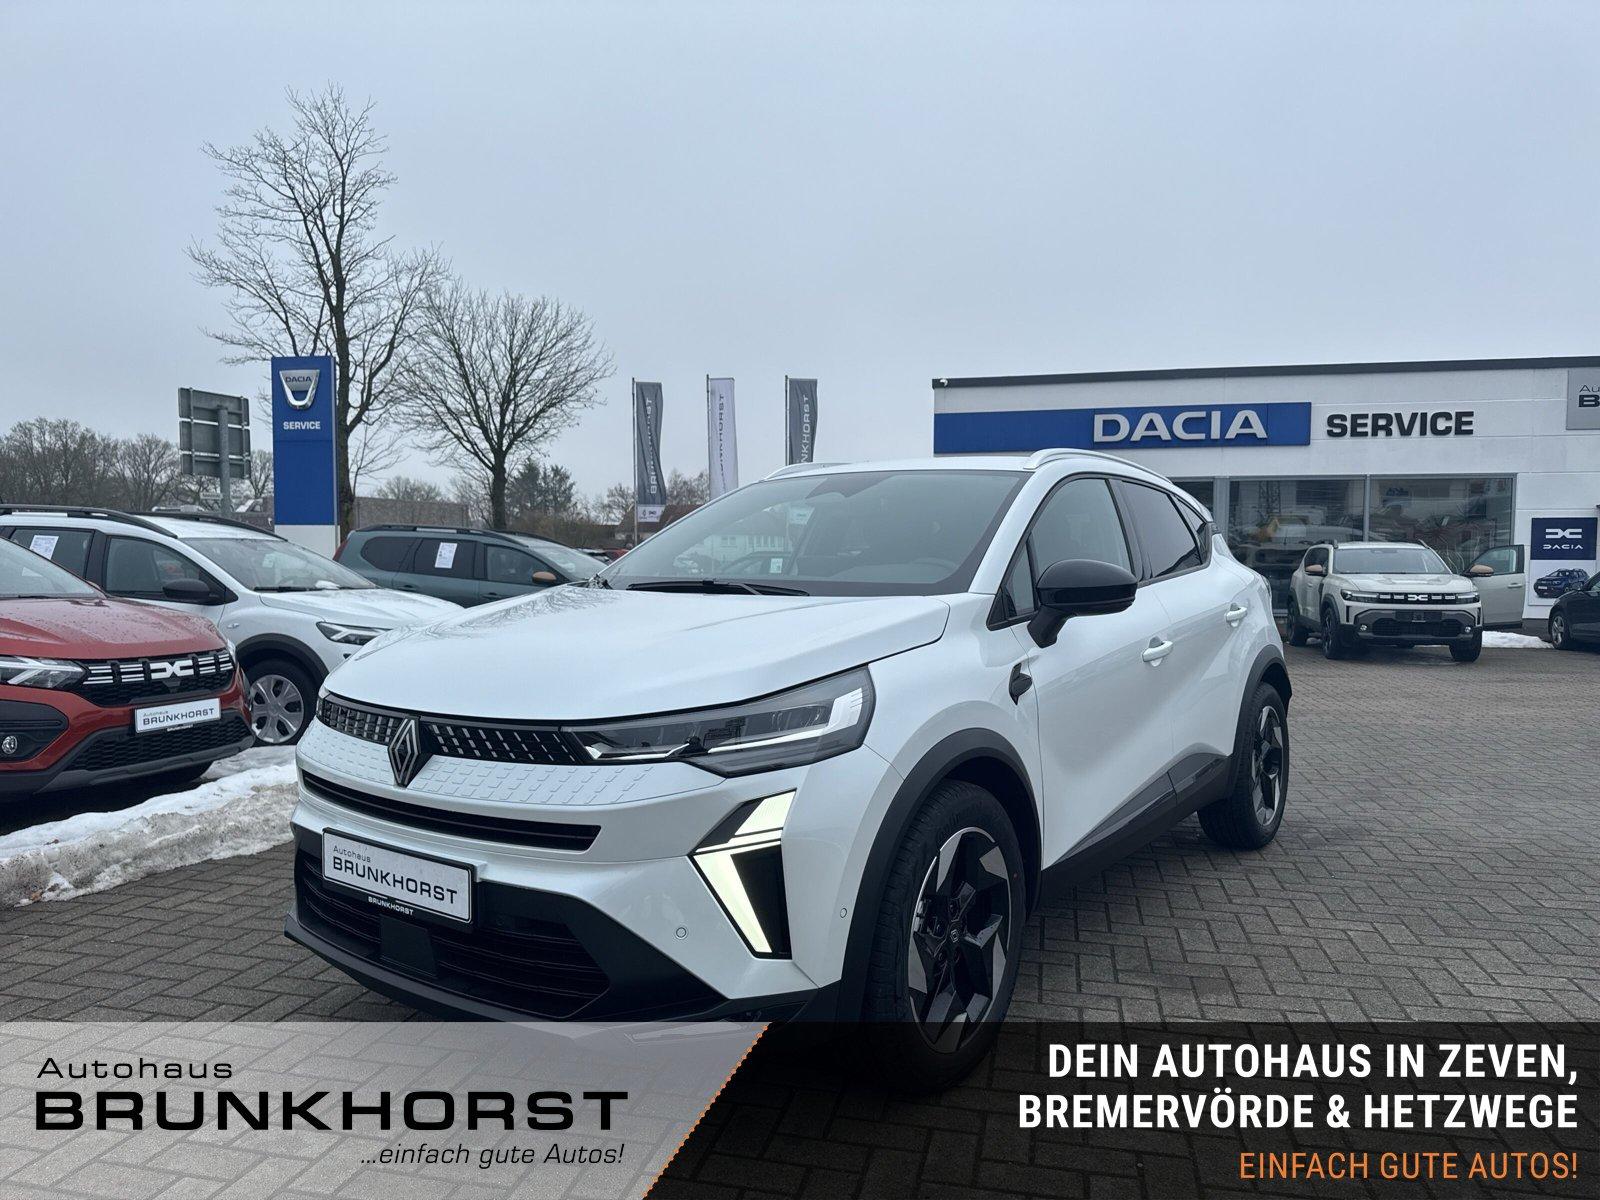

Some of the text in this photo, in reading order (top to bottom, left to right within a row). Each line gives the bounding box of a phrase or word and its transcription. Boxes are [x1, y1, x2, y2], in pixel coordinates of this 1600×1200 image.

[285, 375, 312, 383] DACIA
[283, 421, 321, 430] SERVICE
[1093, 409, 1268, 443] DACIA
[1326, 411, 1475, 438] SERVICE
[142, 707, 215, 726] BRUNKHORST
[333, 844, 372, 863] Autohaus
[332, 855, 458, 904] BRUNKHORST
[368, 896, 414, 916] BRUNKHORST
